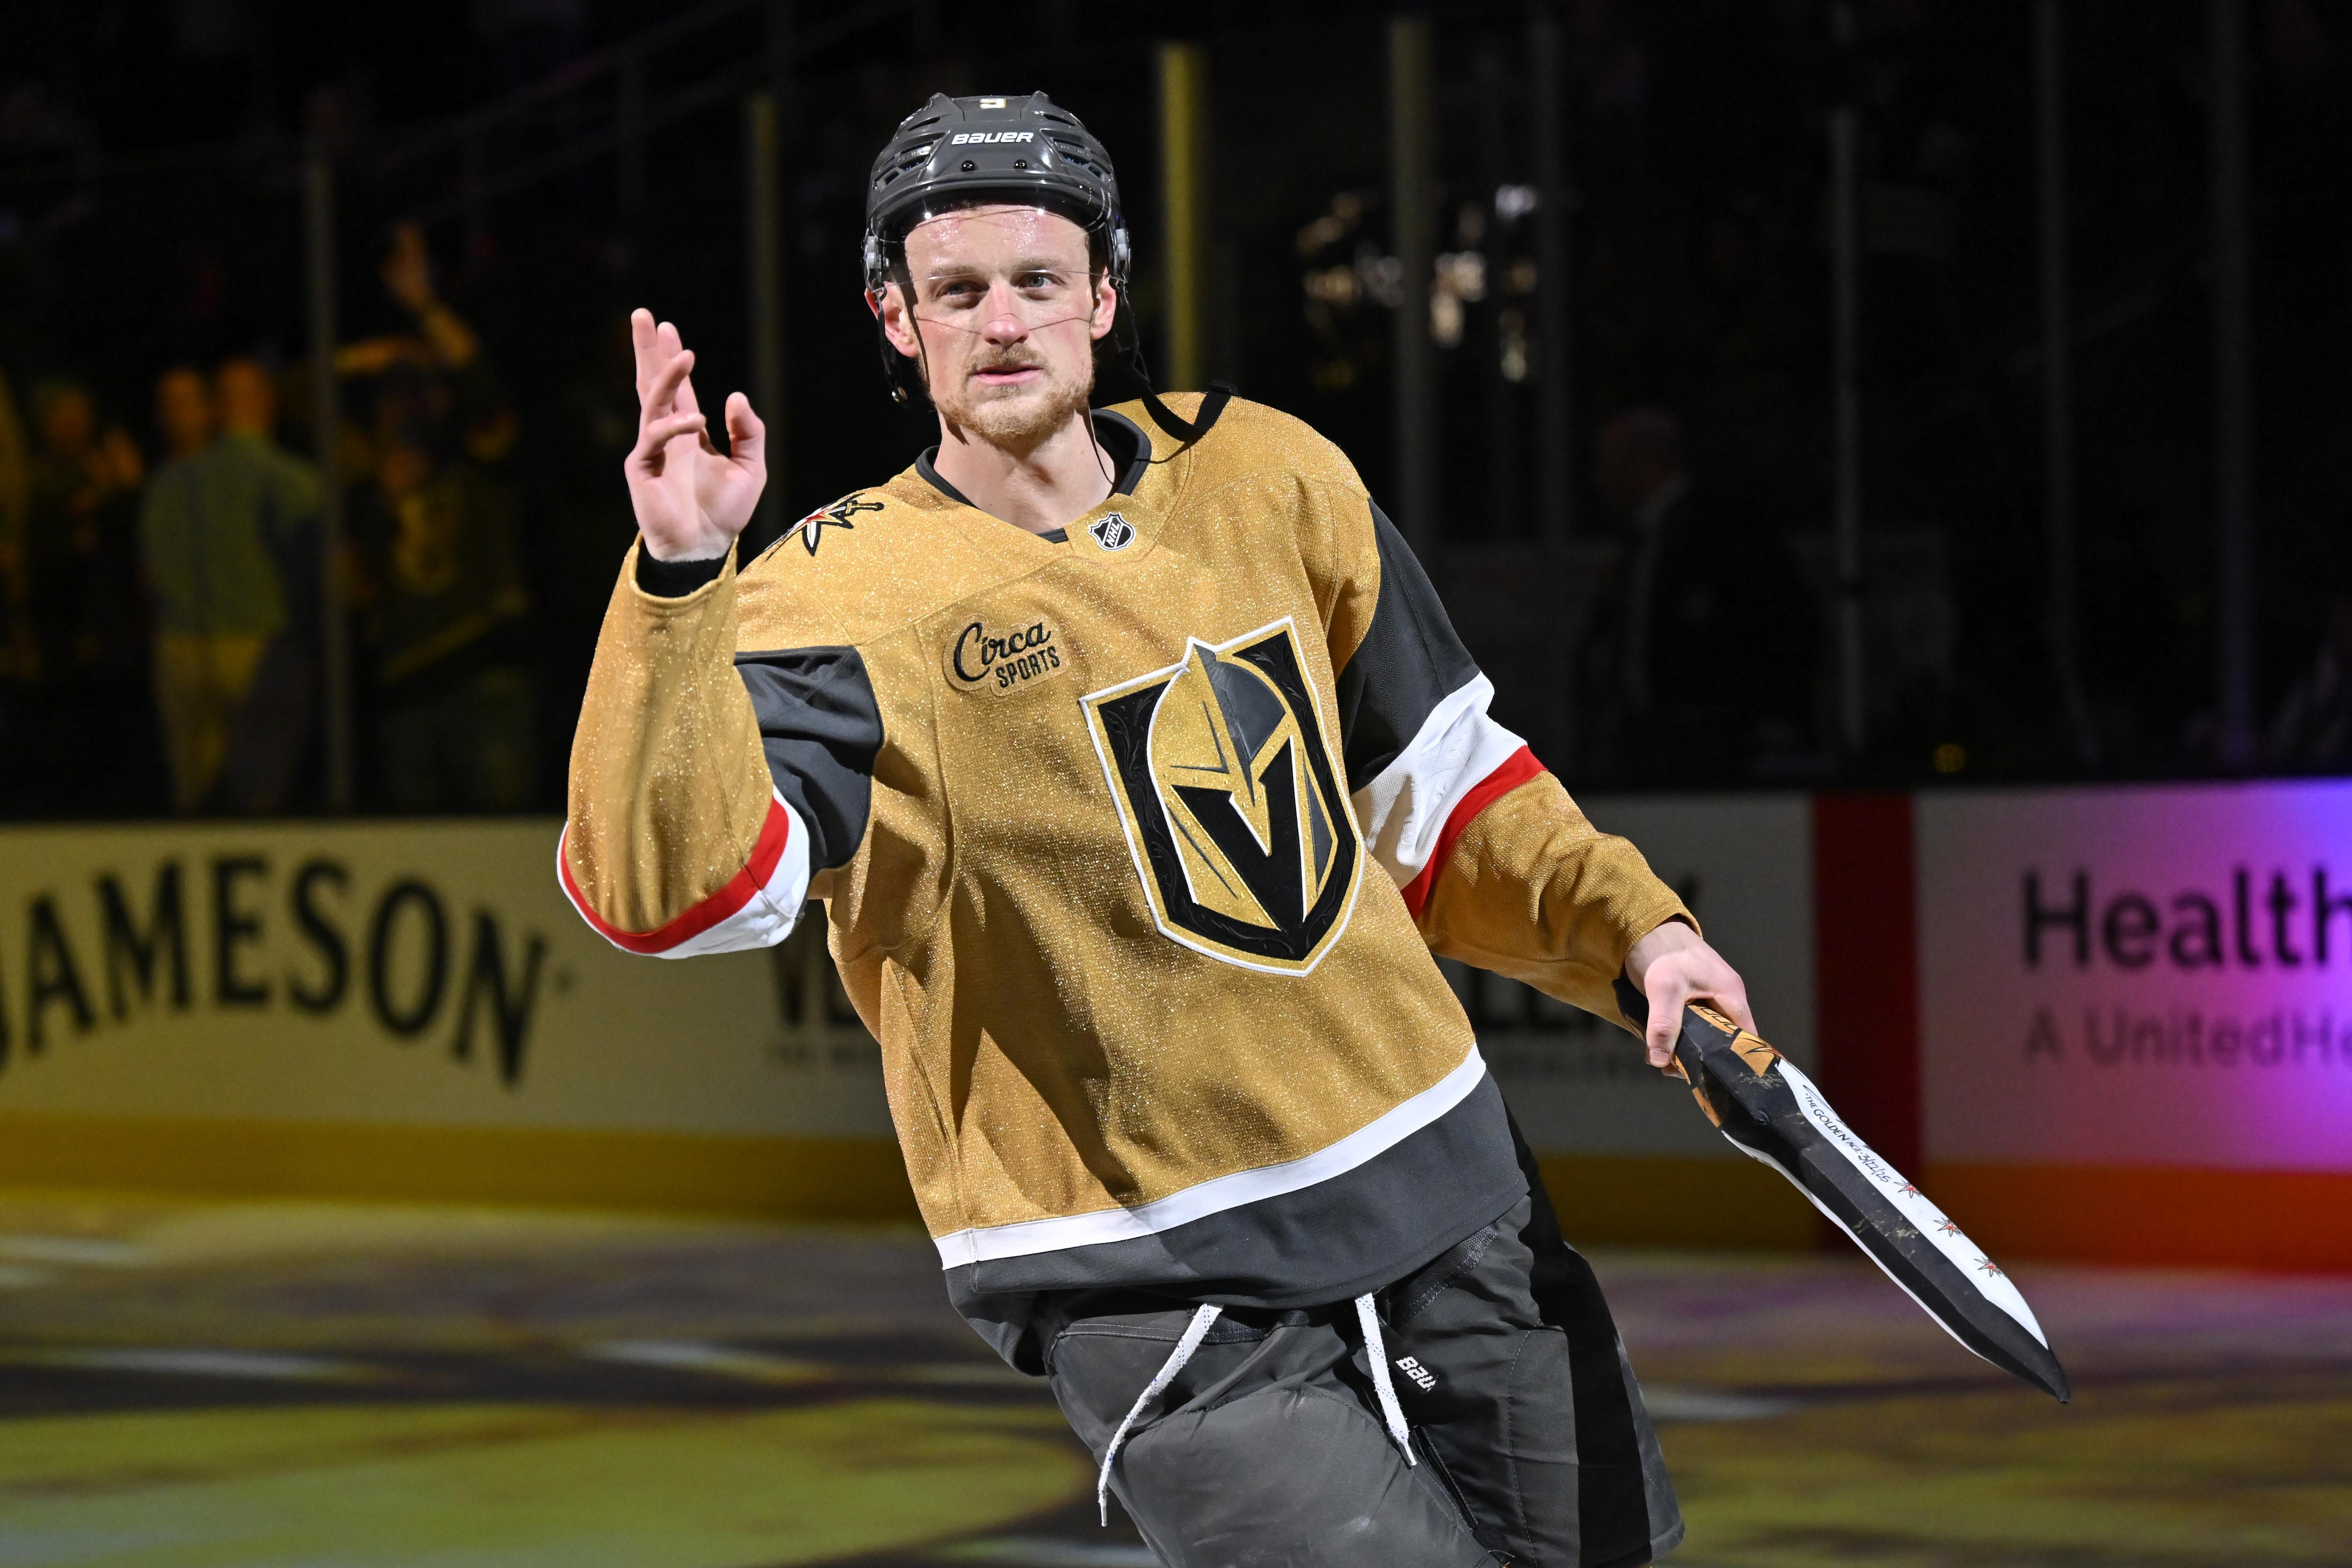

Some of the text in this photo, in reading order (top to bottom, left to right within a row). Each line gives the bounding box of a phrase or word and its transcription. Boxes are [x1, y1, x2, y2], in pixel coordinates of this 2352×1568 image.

[951, 132, 1034, 145] BAUER
[1105, 522, 1120, 547] NHL
[954, 622, 1051, 682] Circa
[995, 645, 1060, 688] SPORTS
[2021, 865, 2352, 967] Health
[1805, 1095, 1818, 1109] THE
[1813, 1109, 1851, 1141] GOLDEN
